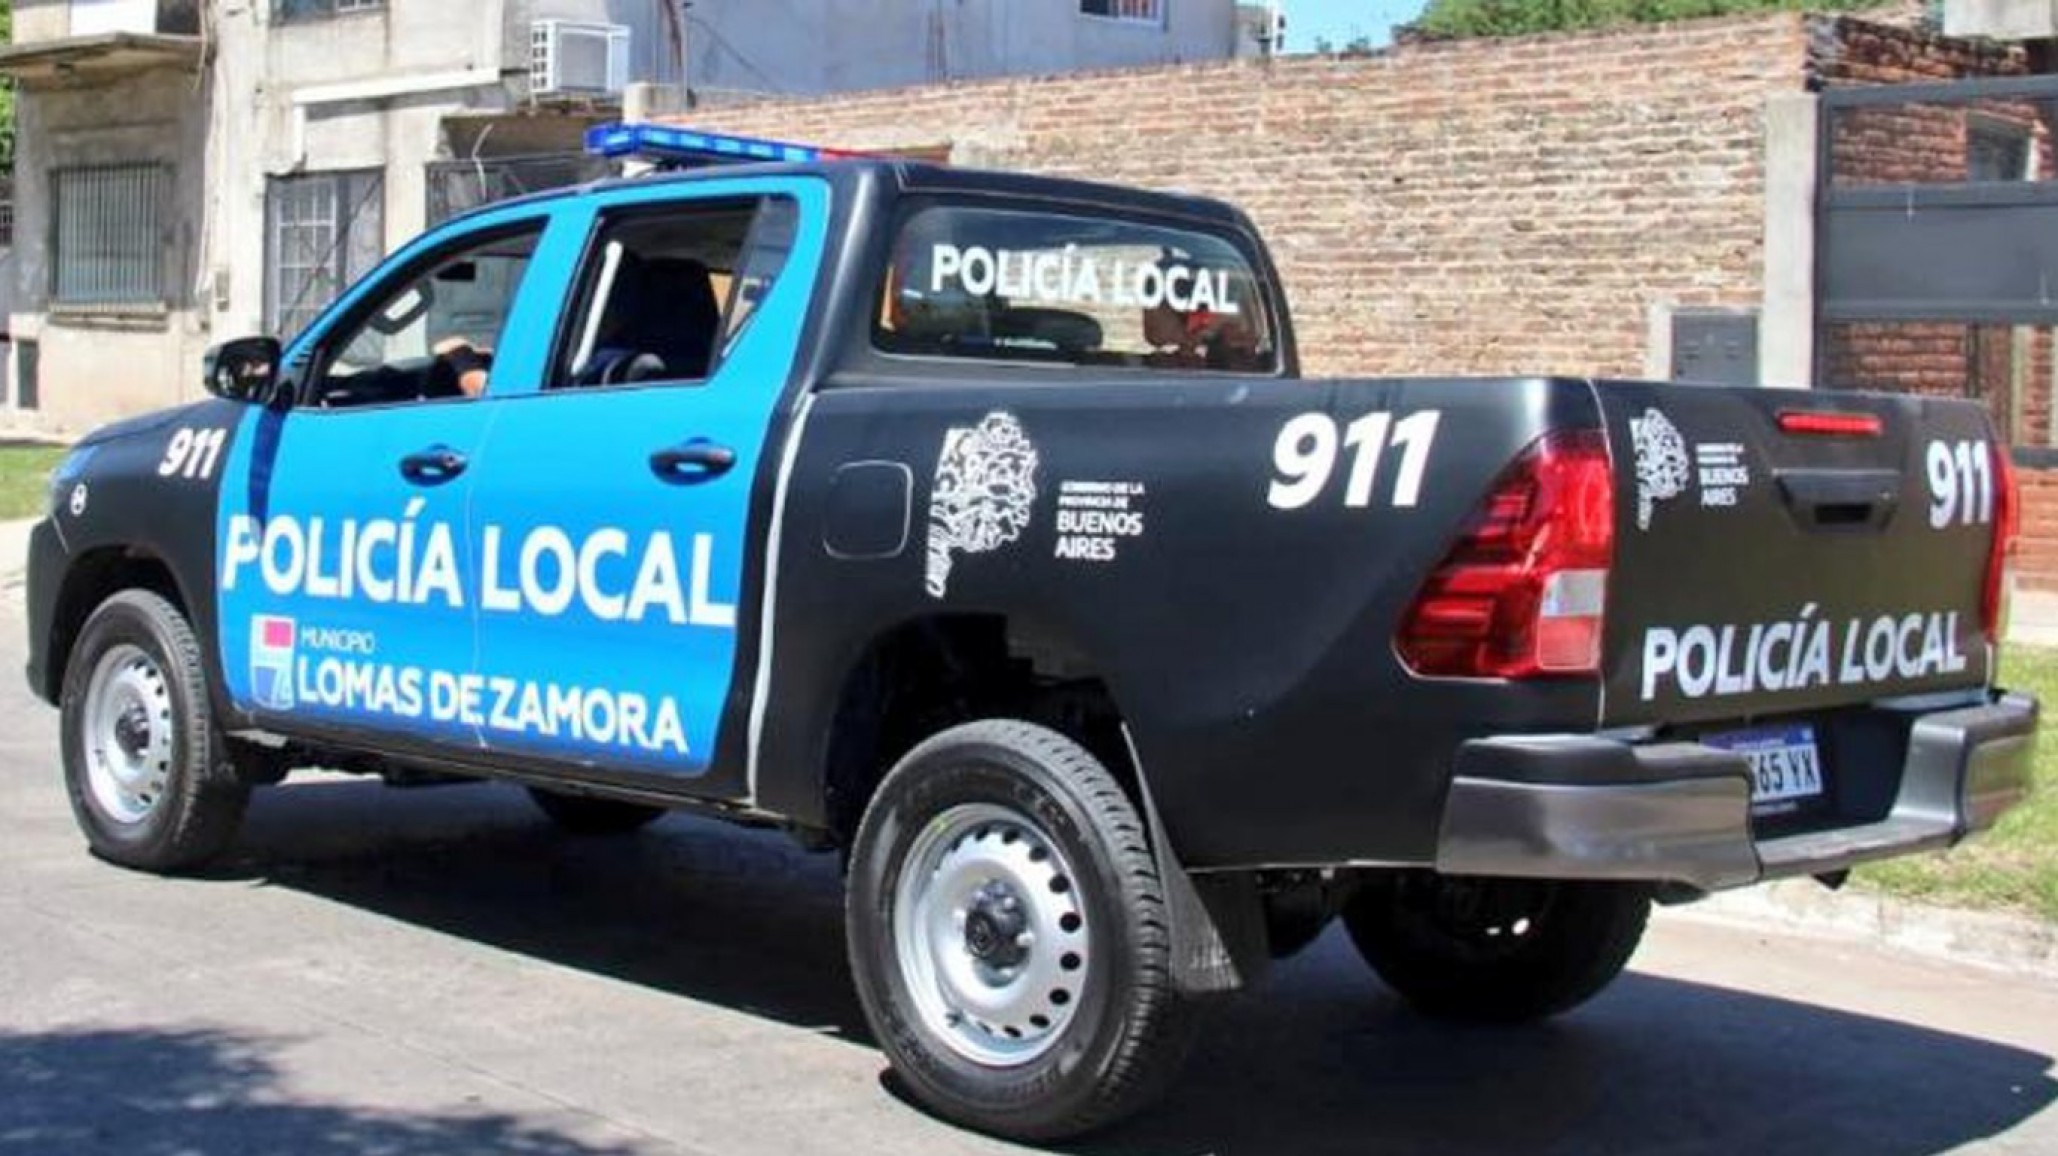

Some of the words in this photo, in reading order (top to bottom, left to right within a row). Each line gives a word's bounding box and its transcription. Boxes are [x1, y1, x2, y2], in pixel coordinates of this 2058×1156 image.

[931, 243, 1101, 302] POLICÍA
[1113, 261, 1239, 313] LOCAL
[158, 428, 227, 479] 911
[1267, 410, 1440, 510] 911
[1926, 440, 1991, 530] 911
[222, 496, 465, 607] POLICÍA
[481, 525, 738, 628] LOCAL
[1054, 535, 1116, 560] AIRES
[1056, 510, 1144, 535] BUENOS
[1641, 602, 1830, 700] POLICÍA
[1839, 611, 1968, 684] LOCAL
[298, 656, 423, 718] LOMAS
[430, 668, 484, 726] DE
[489, 675, 690, 755] ZAMORA
